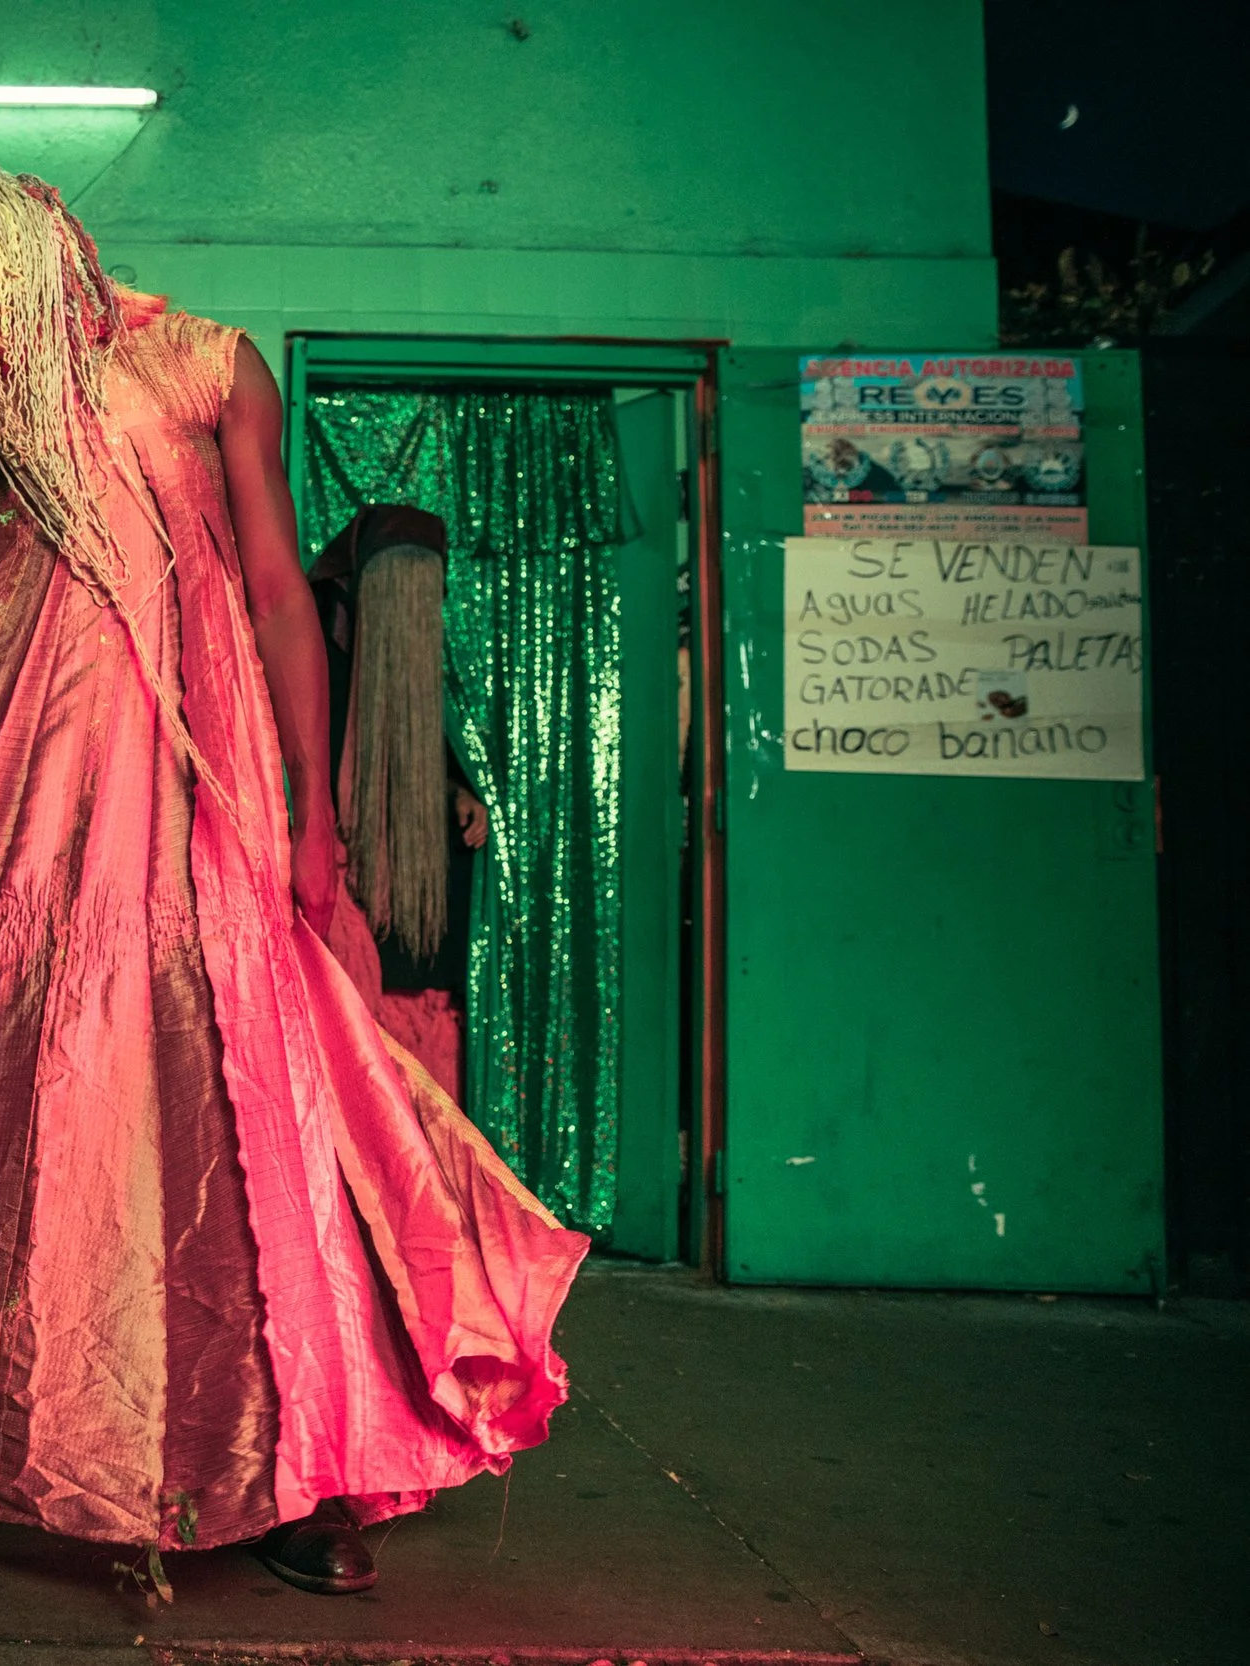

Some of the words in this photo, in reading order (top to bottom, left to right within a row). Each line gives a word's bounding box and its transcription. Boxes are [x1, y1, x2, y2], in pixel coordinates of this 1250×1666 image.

[804, 359, 912, 377] AGENCIA
[922, 359, 1075, 378] AUTORIZADA
[859, 385, 1025, 406] REYES
[847, 540, 914, 580] SE
[932, 539, 1095, 585] VENDEN
[960, 588, 1086, 627] HELADO
[797, 630, 938, 666] SODAS
[1002, 631, 1143, 675] PALETAS
[799, 667, 979, 706] GATORADE
[792, 718, 911, 757] choco
[938, 720, 1108, 760] banano
